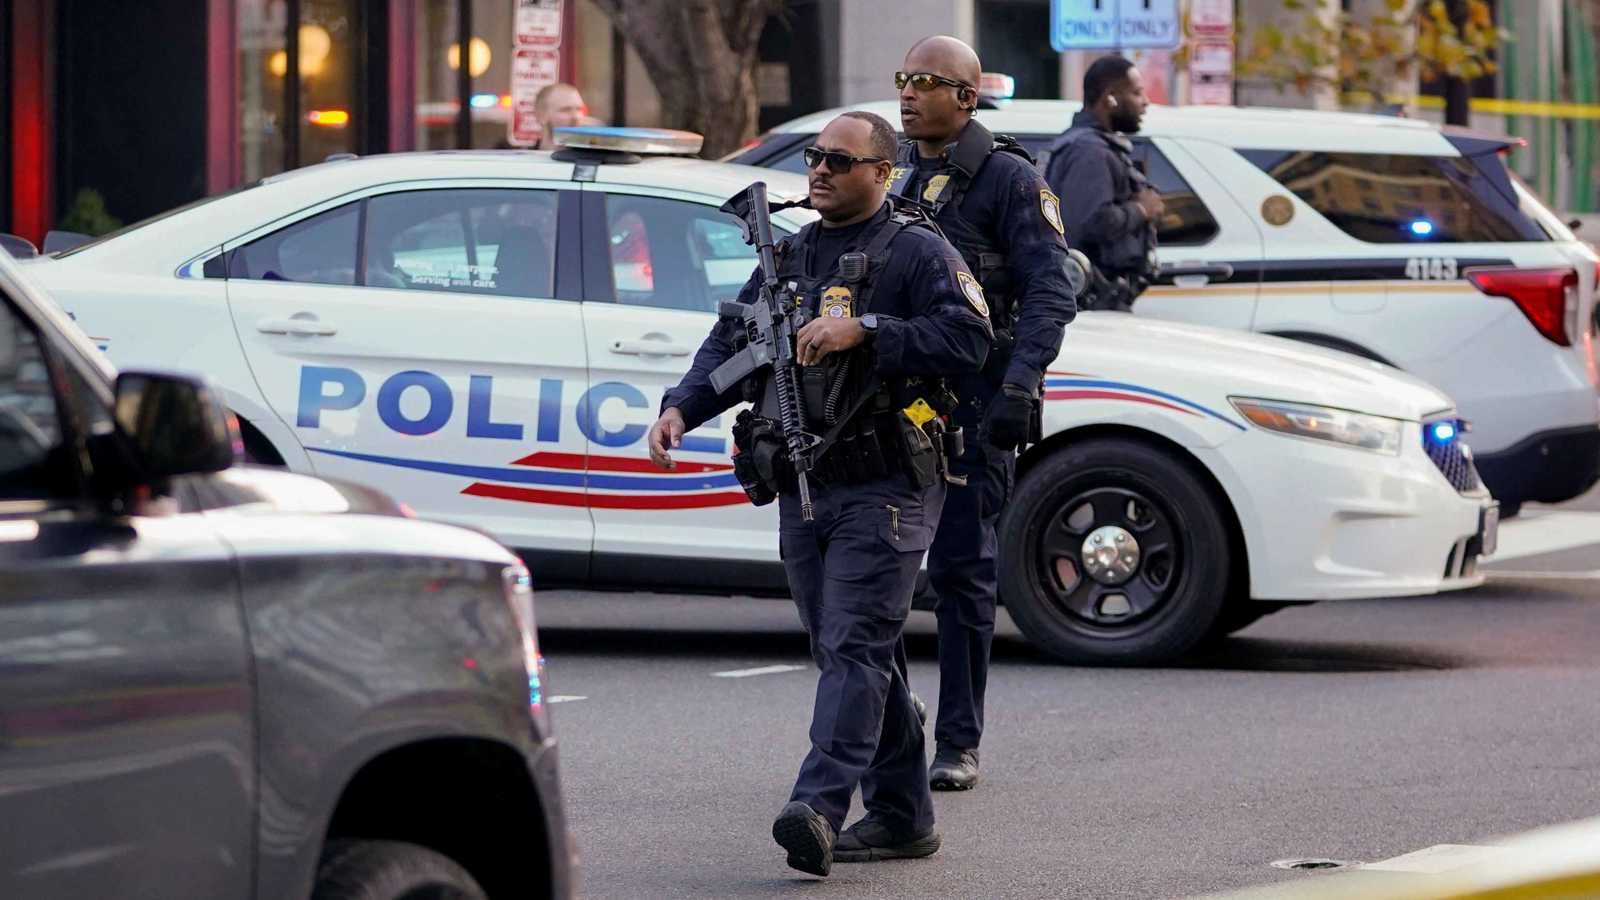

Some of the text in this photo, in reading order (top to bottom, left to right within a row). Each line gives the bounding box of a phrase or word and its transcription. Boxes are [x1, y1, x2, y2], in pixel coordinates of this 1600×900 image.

[1064, 19, 1113, 38] ONLY
[1122, 19, 1170, 38] ONLY
[1405, 257, 1458, 280] 4143
